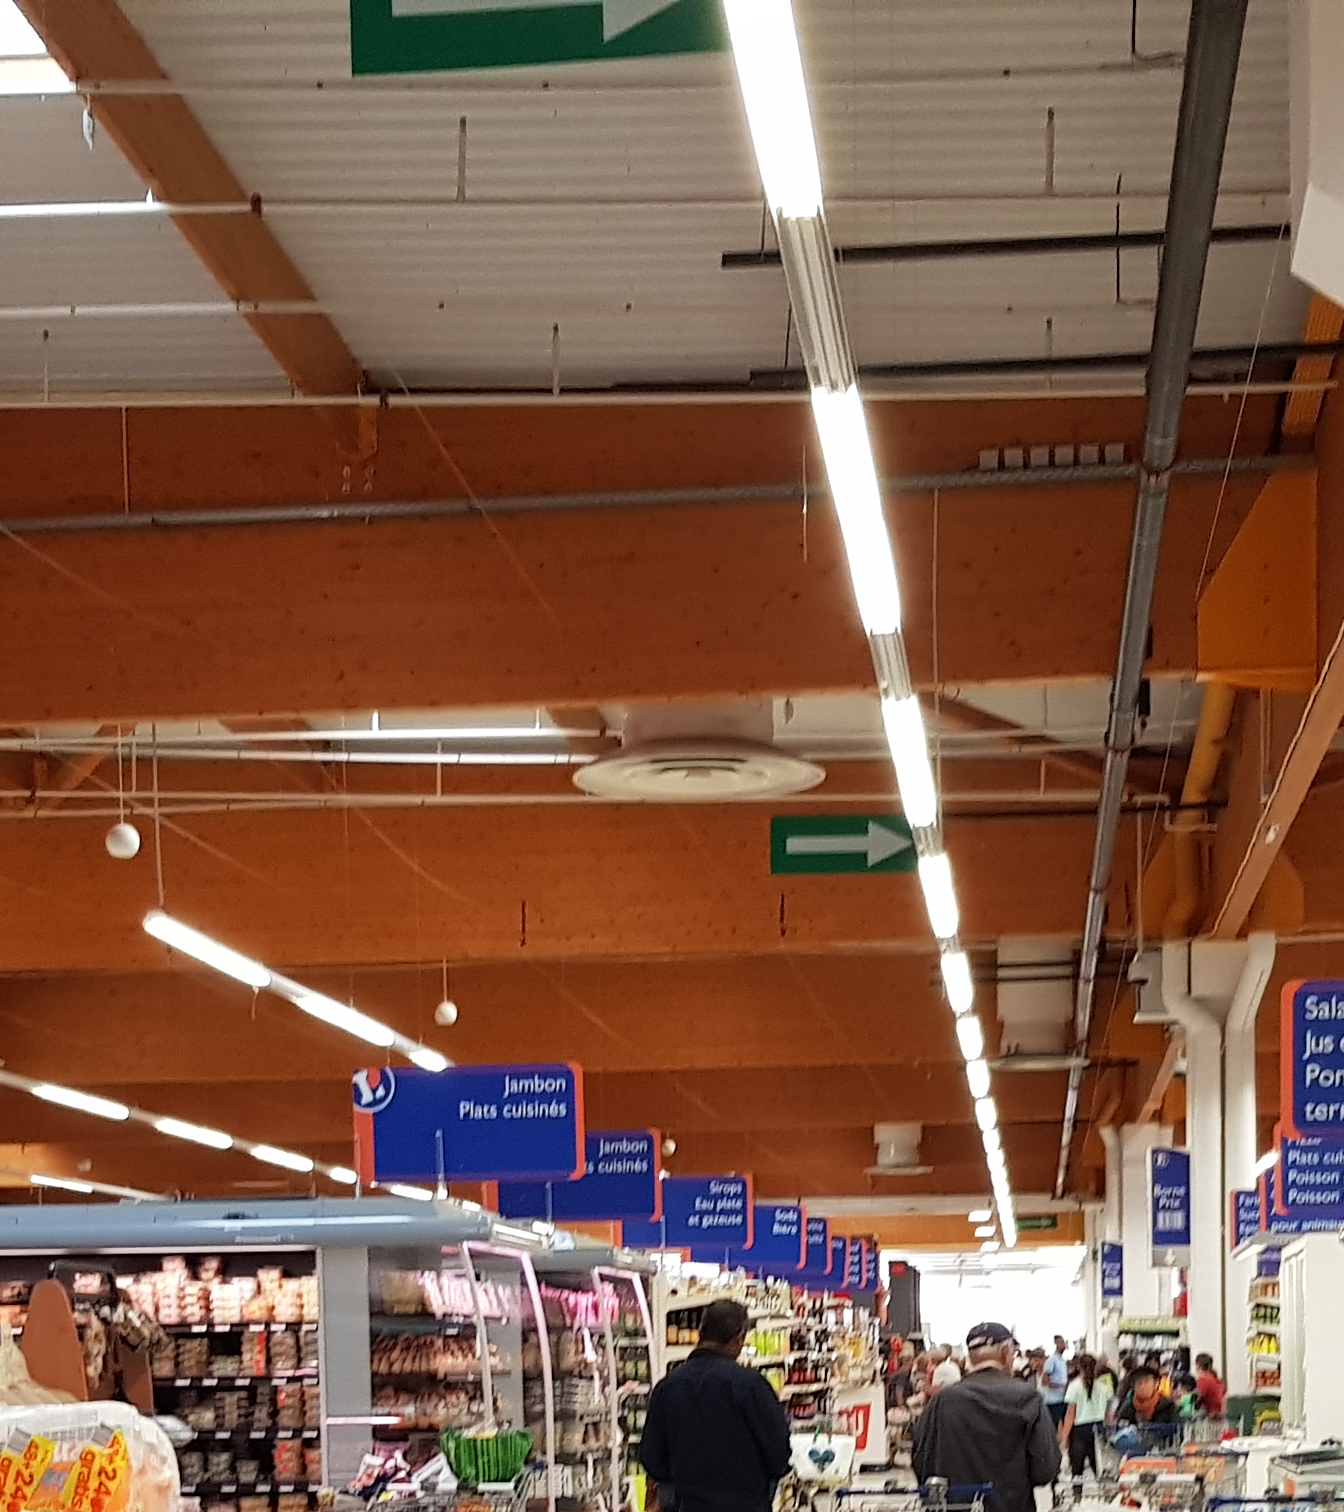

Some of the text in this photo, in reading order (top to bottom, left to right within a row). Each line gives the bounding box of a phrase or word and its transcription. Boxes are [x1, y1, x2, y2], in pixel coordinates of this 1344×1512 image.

[1302, 1028, 1334, 1060] Jus
[502, 1074, 567, 1099] Jambon
[459, 1098, 567, 1120] Plats cuisinés
[599, 1137, 648, 1157] Jambon
[597, 1157, 648, 1174] cuisinés
[1288, 1149, 1319, 1166] Plats
[1288, 1168, 1340, 1186] Poisson
[709, 1179, 743, 1195] Sirops
[694, 1197, 743, 1213] Eau plate
[1288, 1187, 1340, 1206] Poisson
